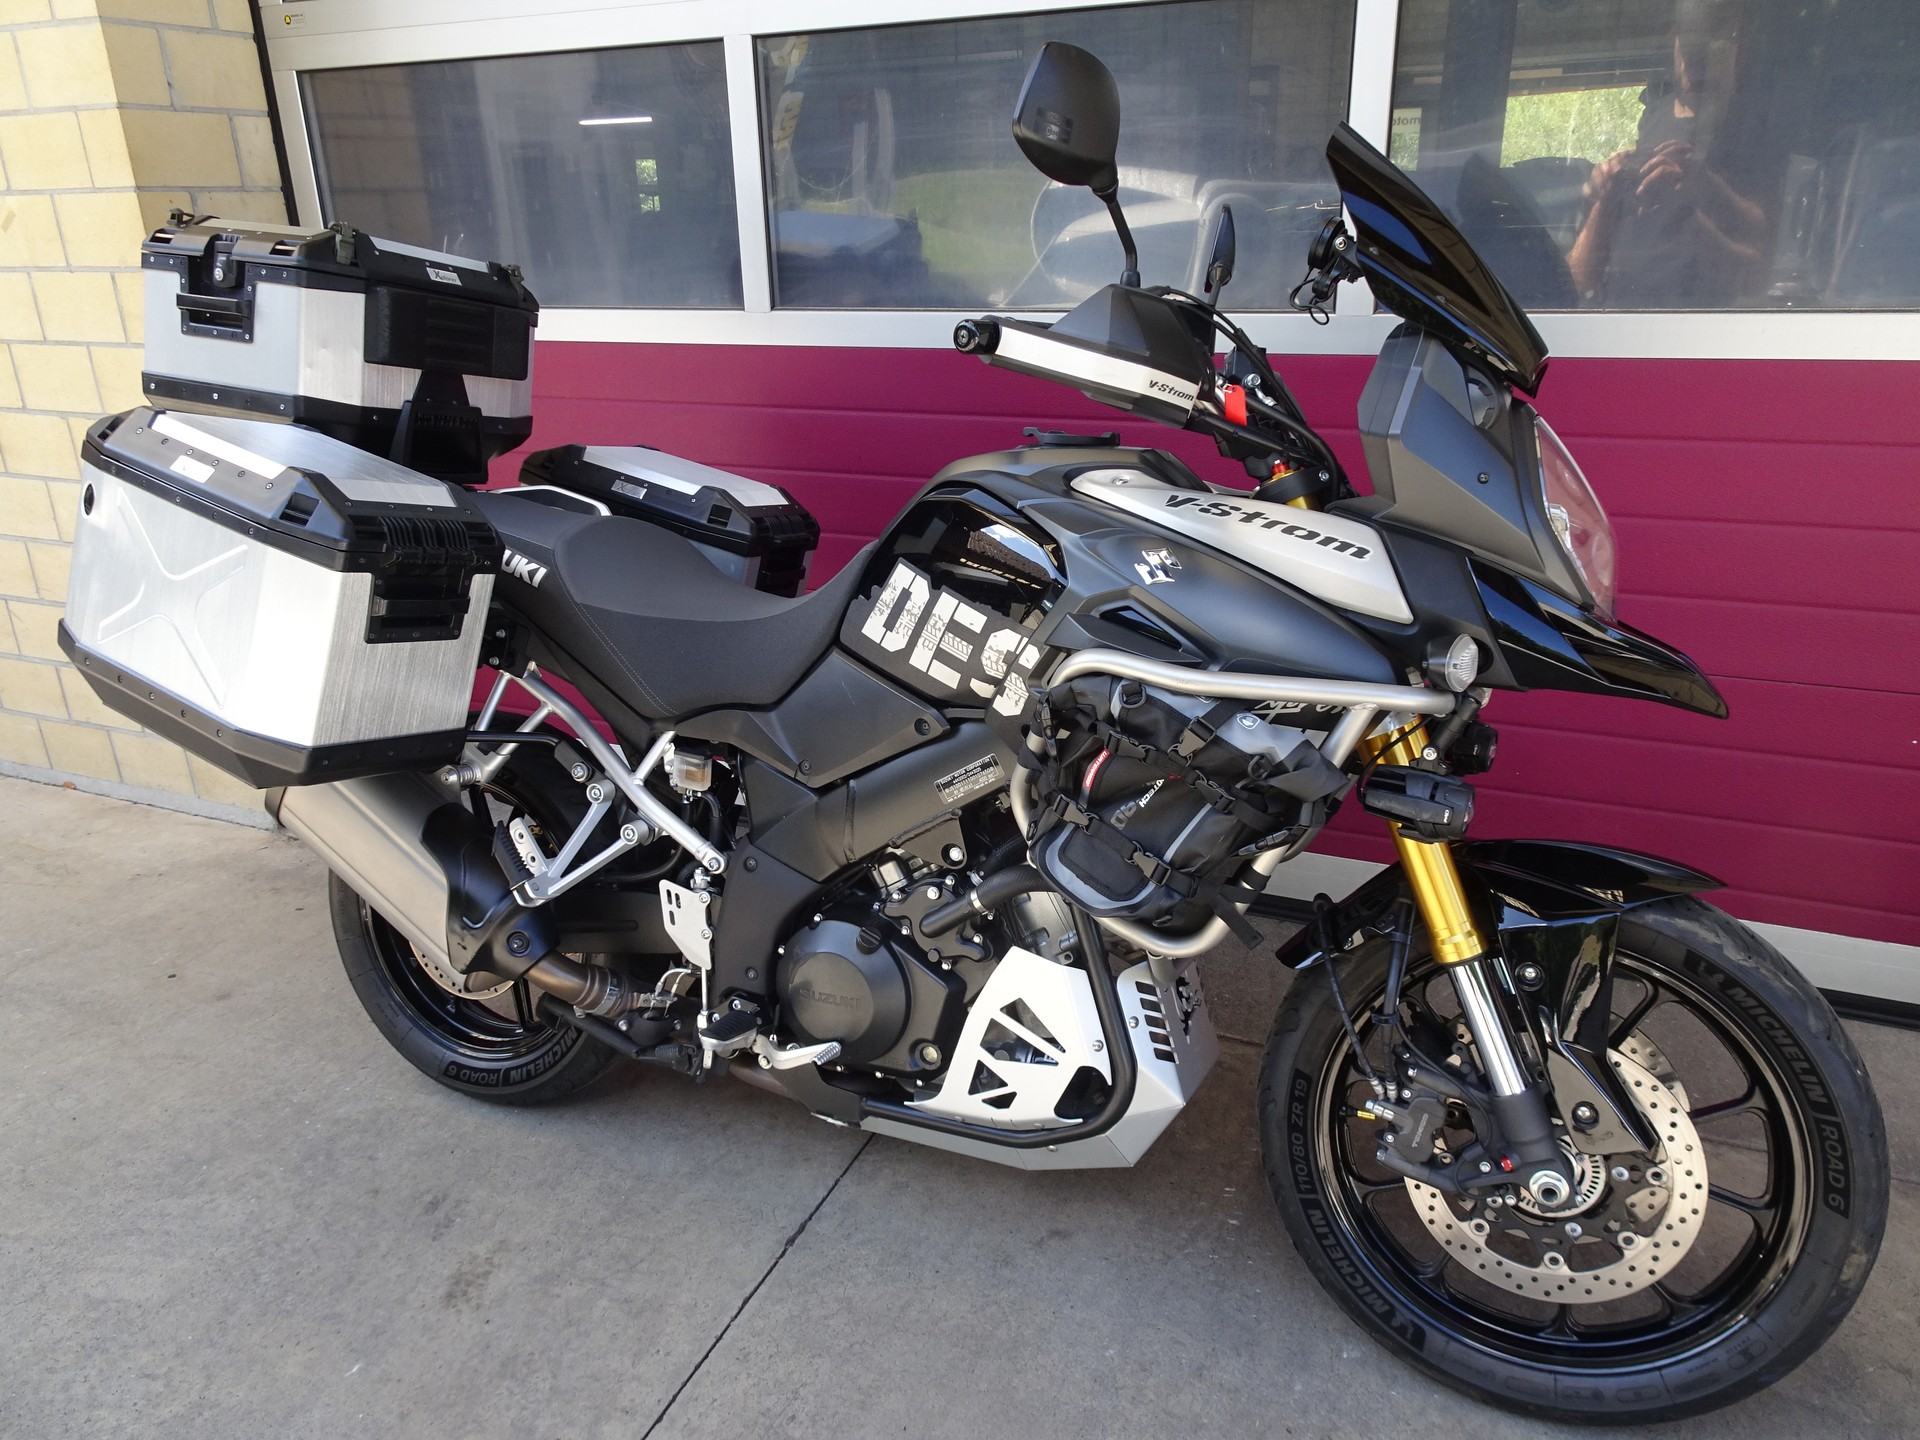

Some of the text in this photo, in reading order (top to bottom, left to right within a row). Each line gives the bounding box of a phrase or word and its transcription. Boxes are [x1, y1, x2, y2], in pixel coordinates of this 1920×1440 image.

[1149, 379, 1195, 402] V-Strom
[1164, 494, 1372, 560] V-Strom
[799, 988, 861, 1009] SUZUKI
[447, 1024, 579, 1085] MICHELIN ROAD 6
[1726, 985, 1845, 1212] MICHELIN ROAD 6
[1291, 1078, 1312, 1192] 110/80 ZR 19
[1306, 1208, 1391, 1314] MICHELIN
